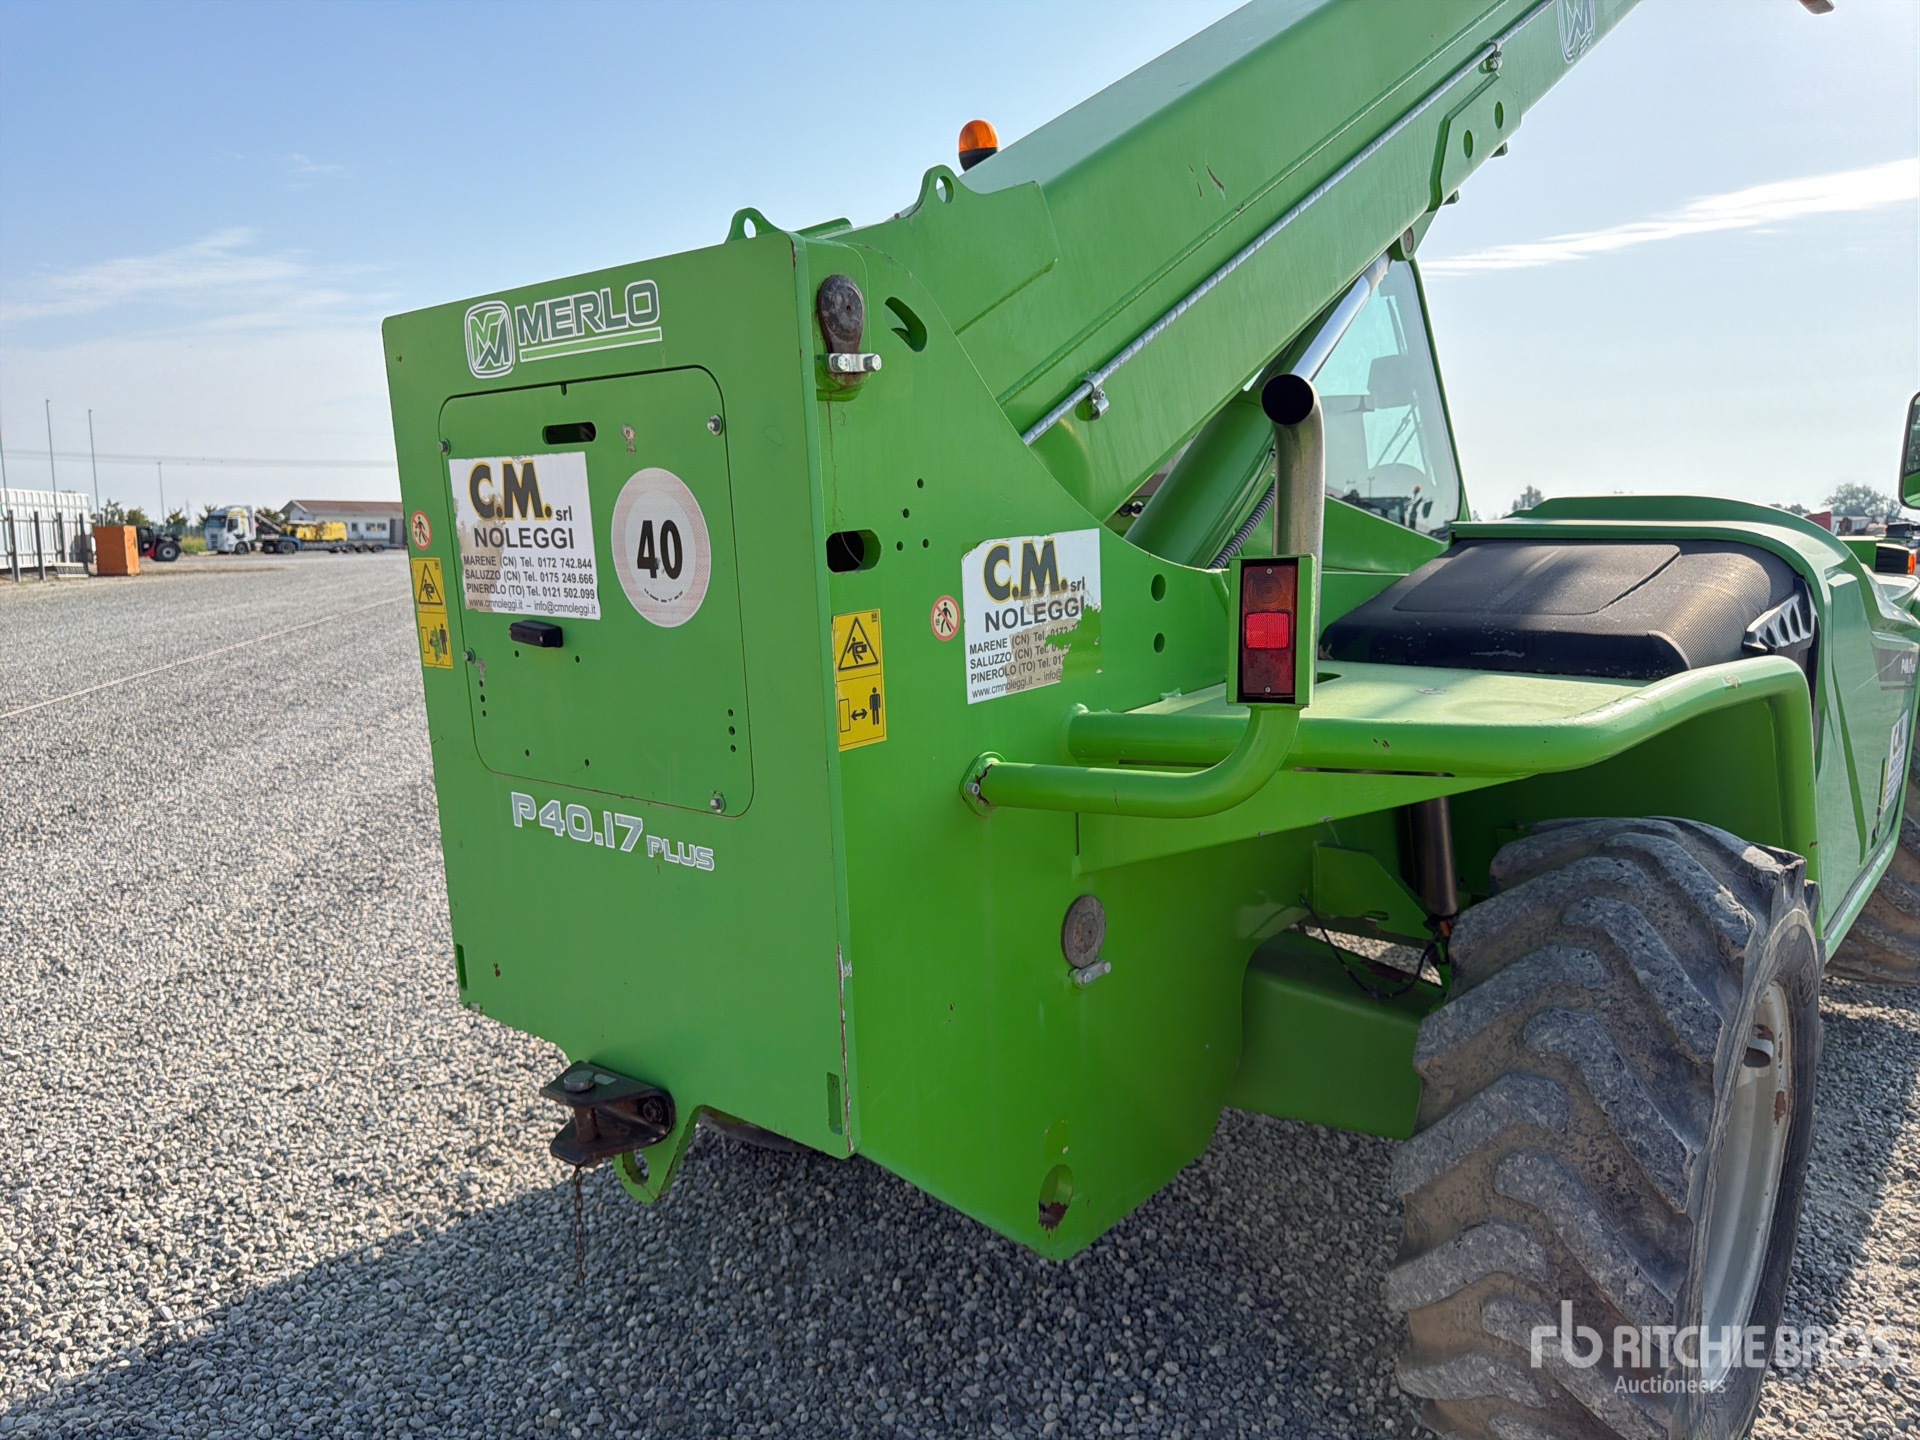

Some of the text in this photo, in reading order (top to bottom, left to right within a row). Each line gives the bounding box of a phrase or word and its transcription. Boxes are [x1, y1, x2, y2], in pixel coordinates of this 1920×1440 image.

[514, 279, 660, 346] MERLO
[468, 460, 573, 522] C.M. srl
[474, 527, 574, 549] NOLEGGI
[636, 519, 683, 580] 40
[463, 555, 592, 569] MARENE (CN) Tel. 0172 742.844
[982, 538, 1085, 604] C.M. srl
[465, 569, 594, 585] SALUZZO (CN) Tel. 0175 249.666
[466, 583, 595, 600] PINEROLO (TO) Tel. 0121 502.099
[468, 599, 524, 611] www.cmnoleggi.it
[533, 600, 597, 617] info@cmnoleggi.it
[984, 595, 1085, 633] NOLEGGI
[969, 638, 1008, 655] MARENE
[1011, 633, 1030, 649] (CN)
[1033, 630, 1046, 642] Tel.
[970, 651, 1012, 670] SALUZZO
[1015, 647, 1033, 663] (CN)
[1035, 645, 1049, 655] Tel.
[970, 665, 1017, 685] PINEROLO
[1019, 660, 1036, 676] (TO)
[1038, 658, 1051, 669] Tel.
[972, 675, 1033, 699] www.cmnoleggi.it
[511, 791, 715, 872] P40.17 PLUS
